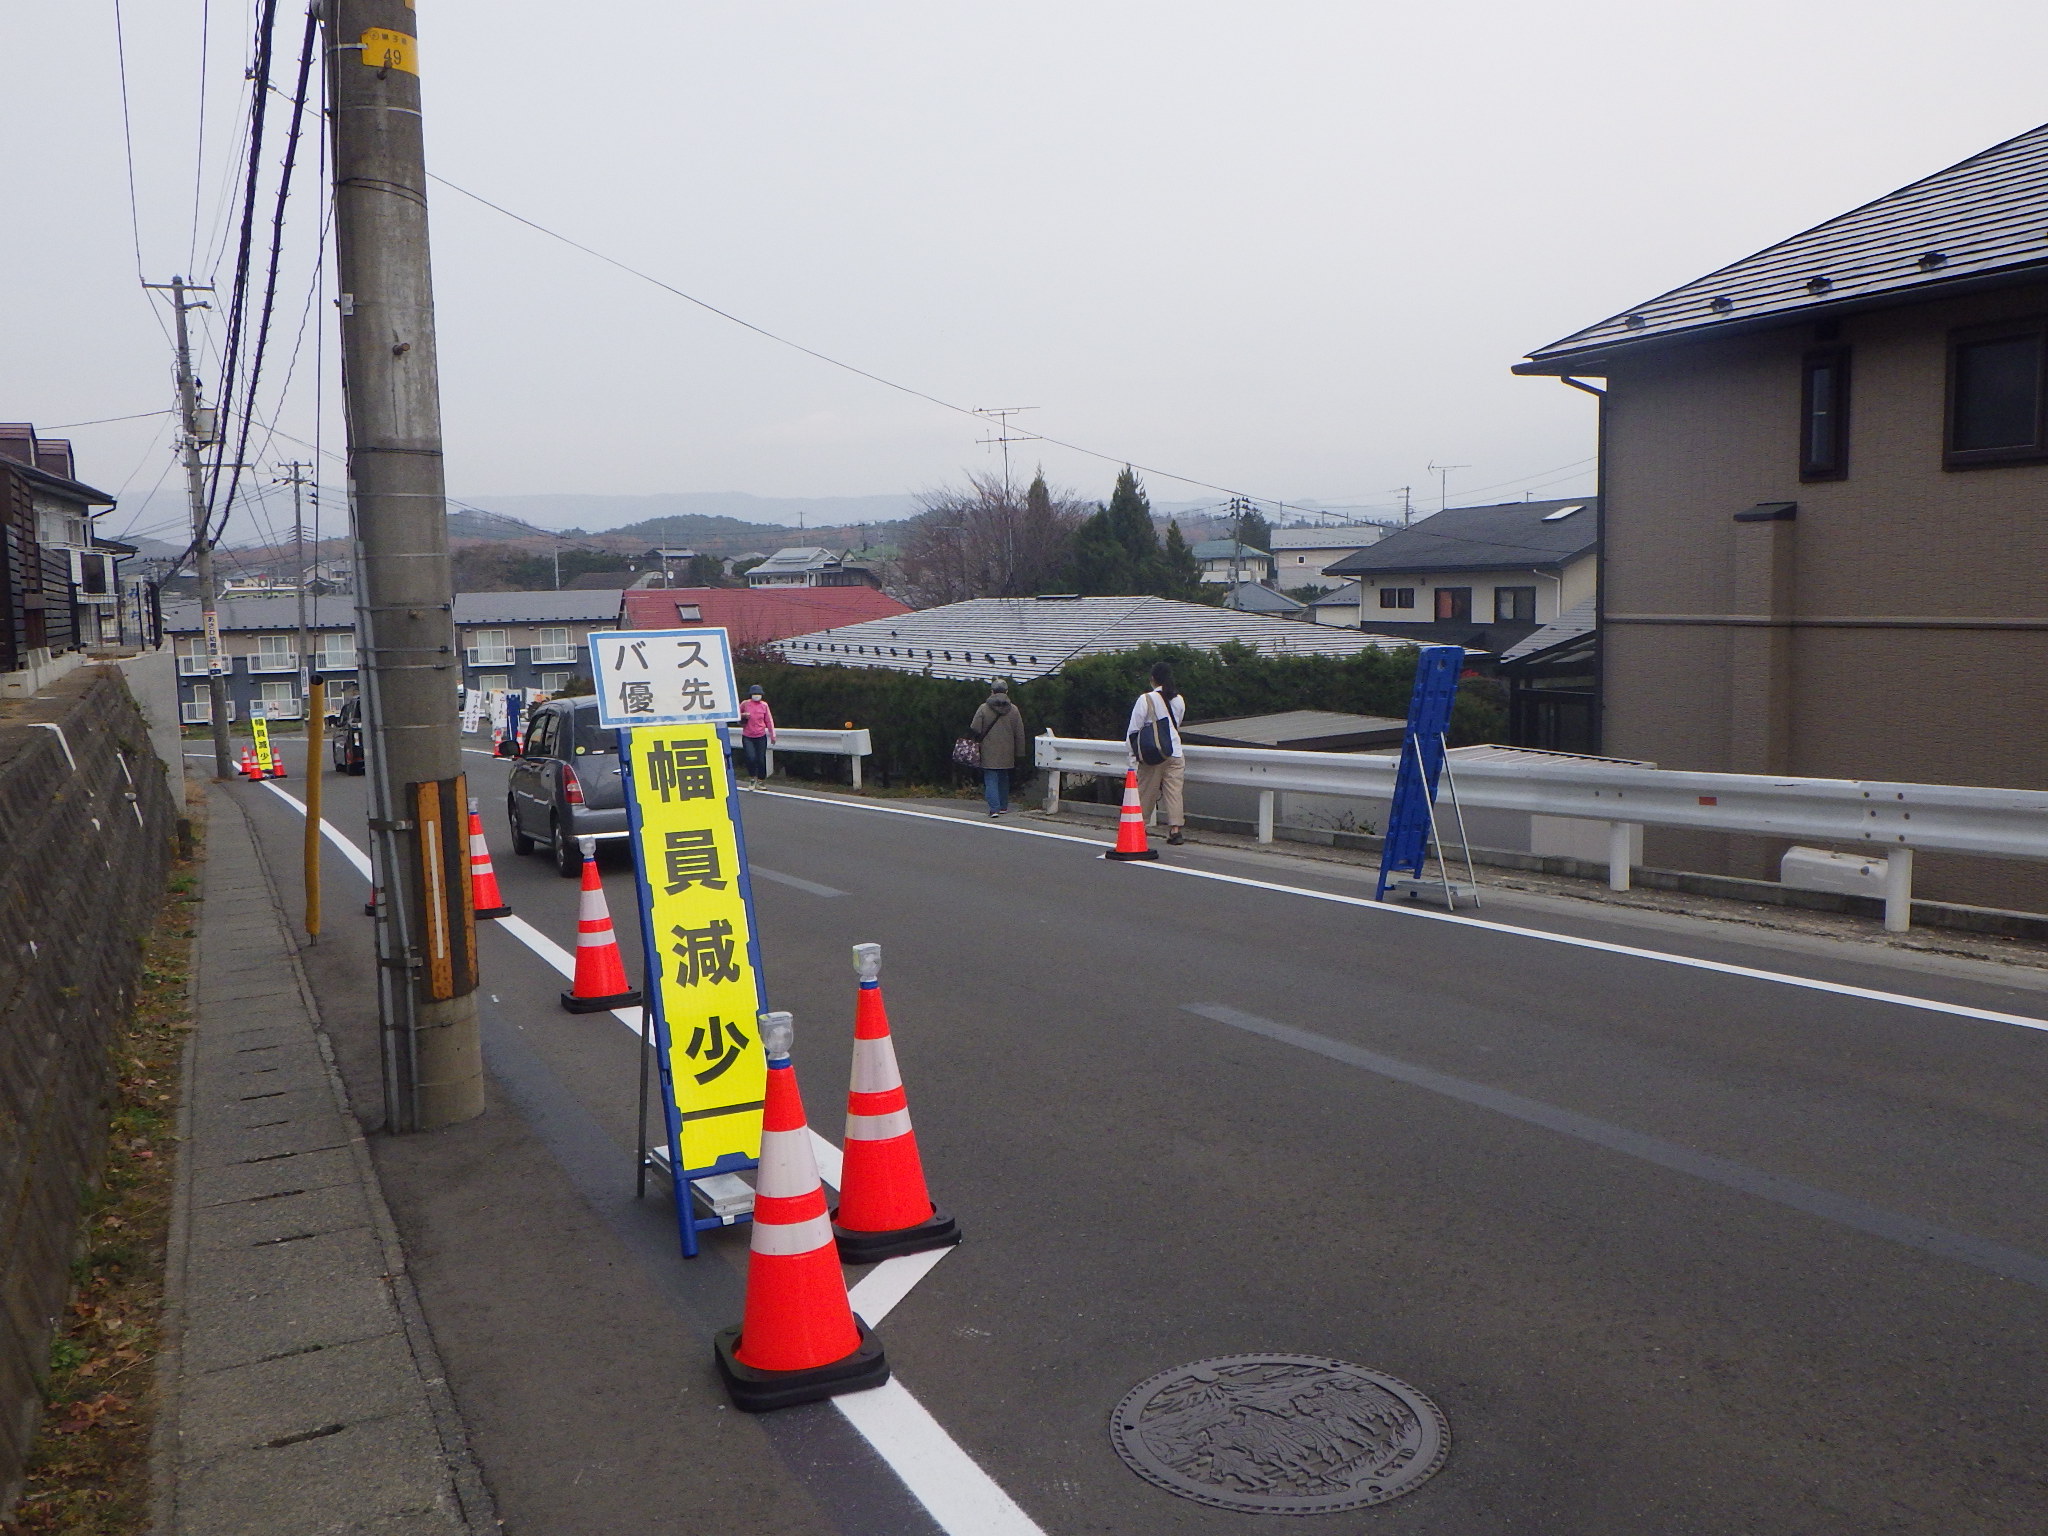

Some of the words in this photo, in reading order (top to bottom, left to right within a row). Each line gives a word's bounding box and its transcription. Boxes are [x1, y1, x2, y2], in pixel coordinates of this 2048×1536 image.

[384, 48, 401, 65] 49
[615, 640, 709, 671] バス
[619, 677, 716, 714] 優先
[647, 739, 750, 1085] 幅員減少
